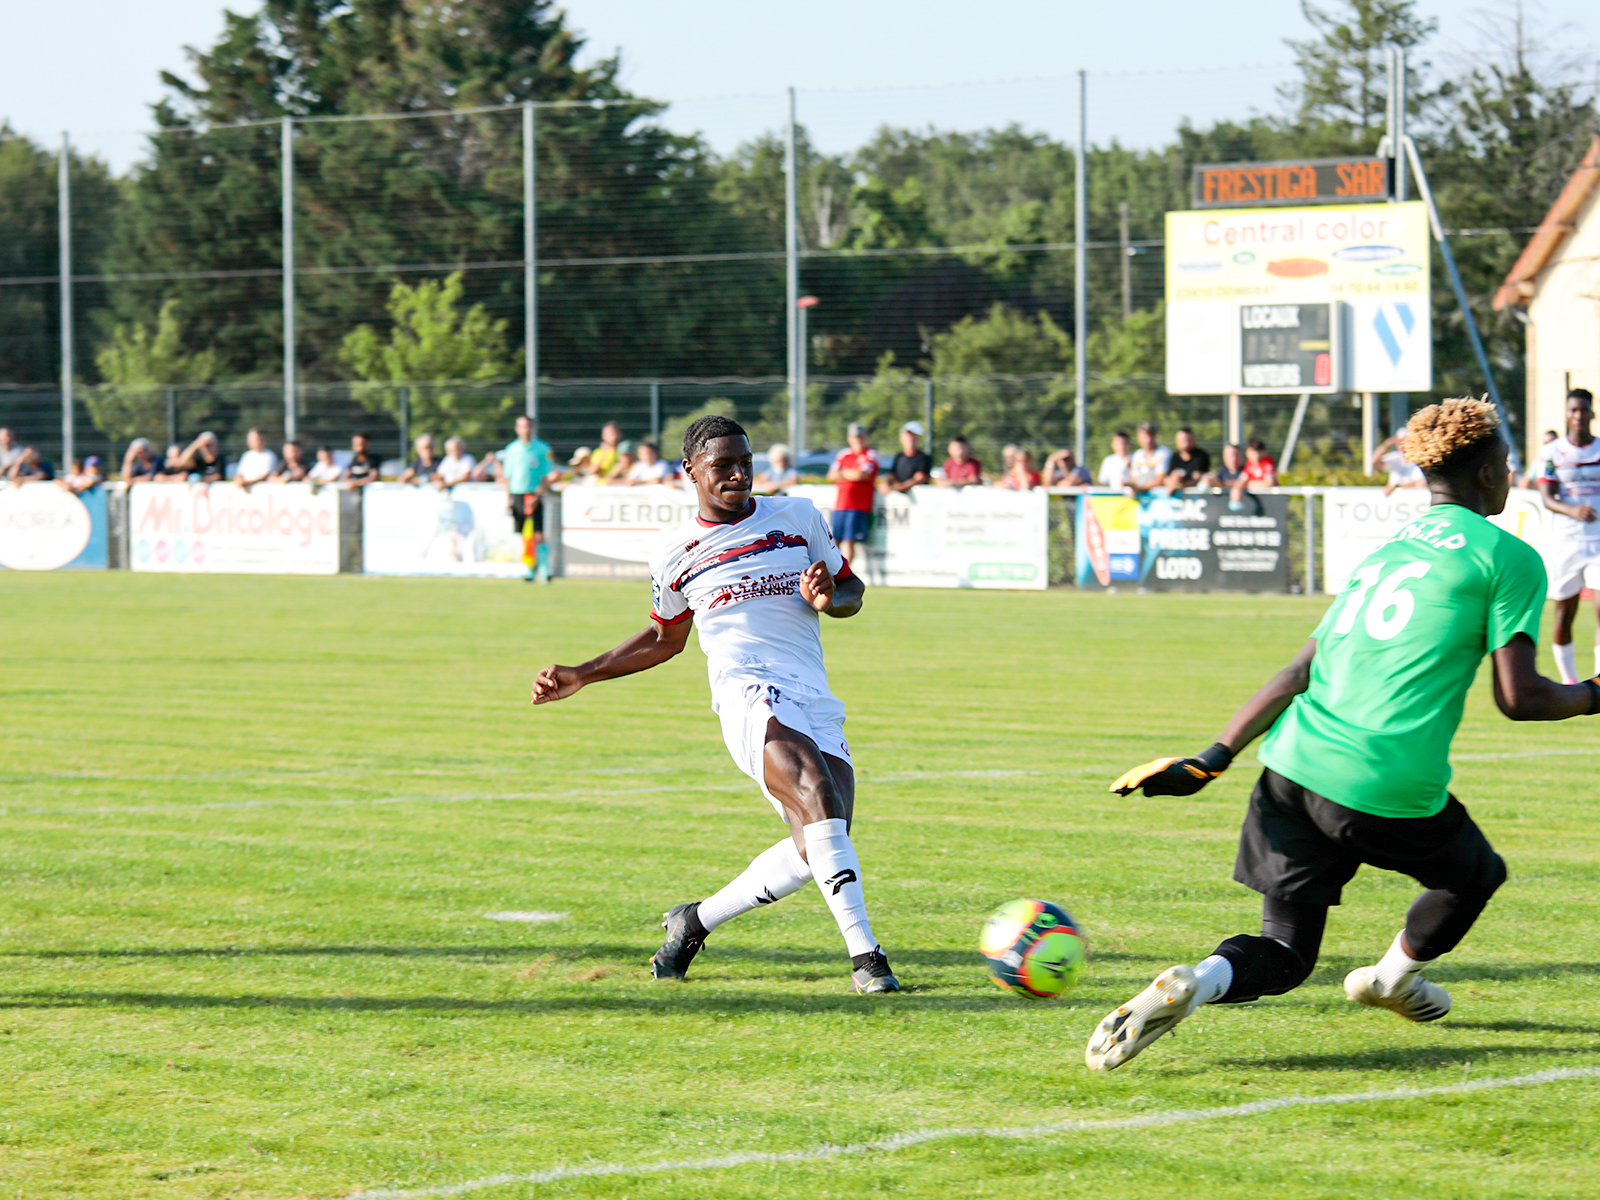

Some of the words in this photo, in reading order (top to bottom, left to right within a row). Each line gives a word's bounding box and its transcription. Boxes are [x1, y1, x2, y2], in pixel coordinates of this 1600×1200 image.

[1203, 217, 1304, 245] Central
[1315, 213, 1388, 241] color
[687, 556, 721, 577] PATRICK
[1156, 556, 1203, 580] LOTO
[1332, 560, 1432, 640] 16
